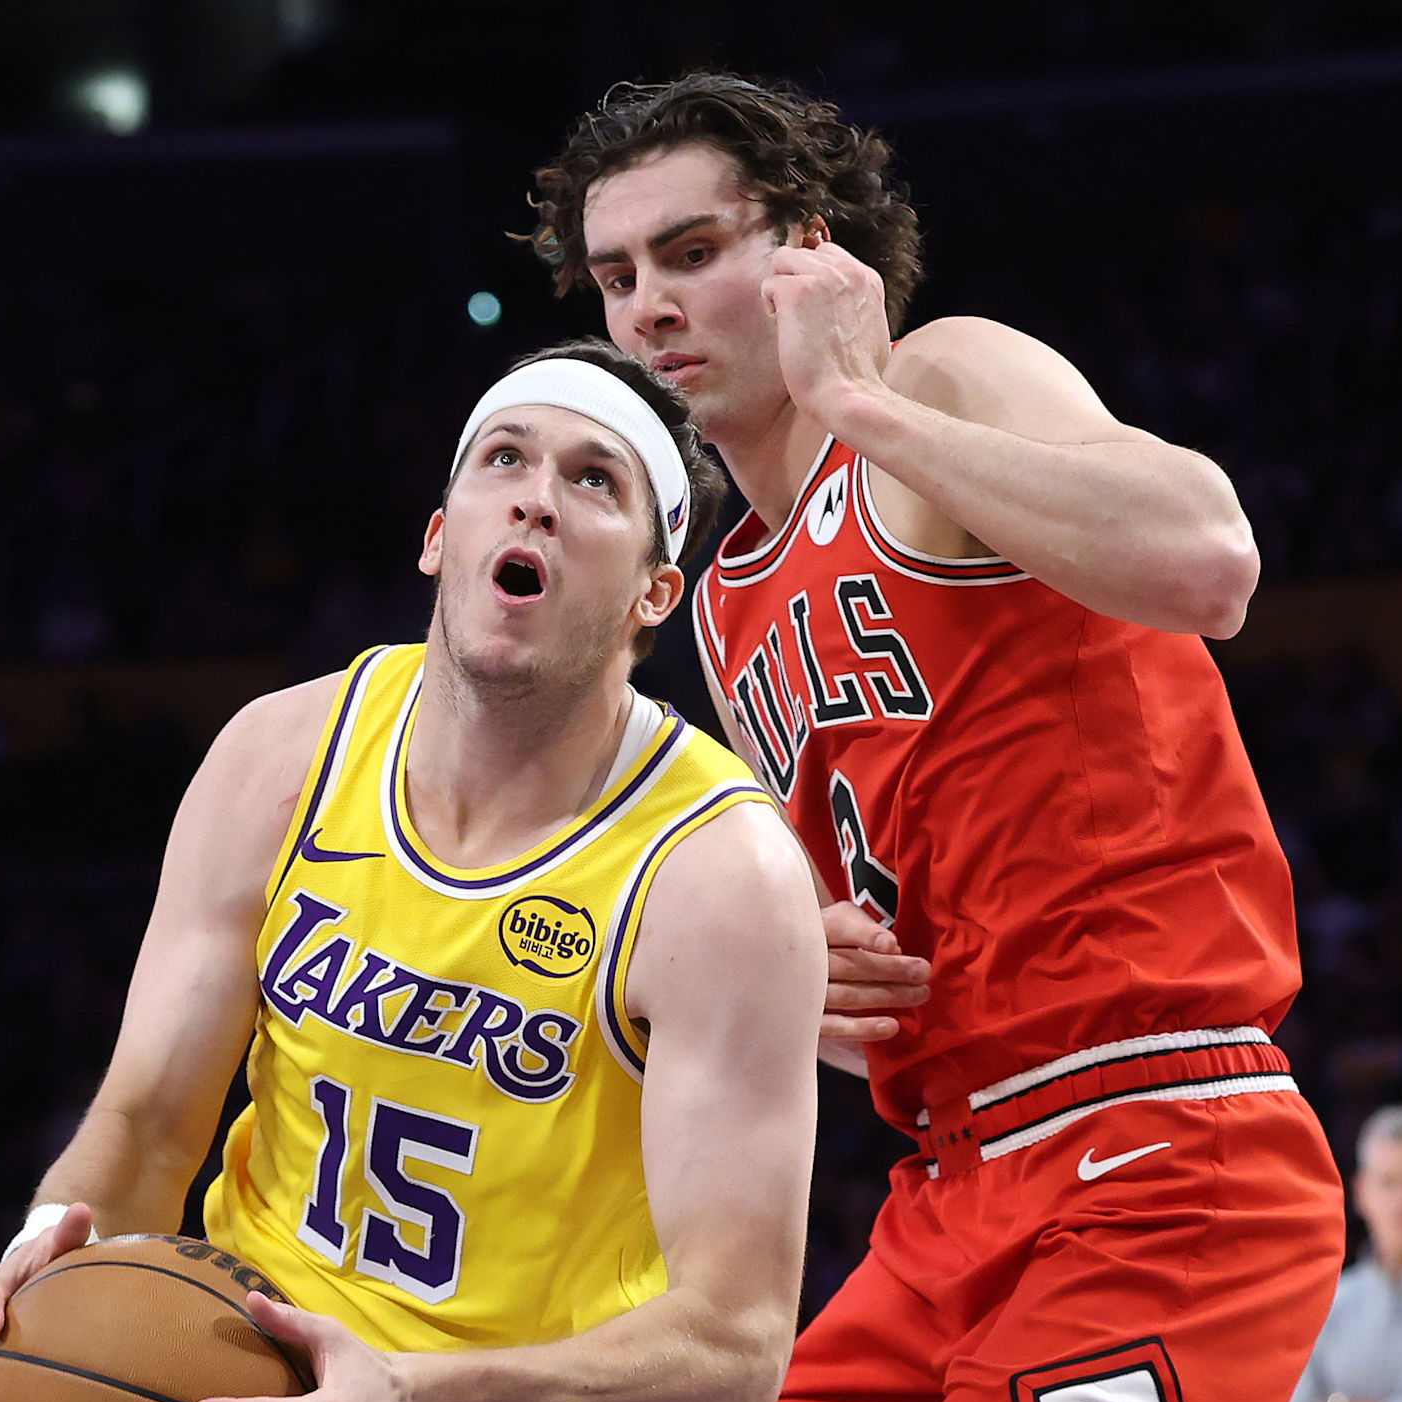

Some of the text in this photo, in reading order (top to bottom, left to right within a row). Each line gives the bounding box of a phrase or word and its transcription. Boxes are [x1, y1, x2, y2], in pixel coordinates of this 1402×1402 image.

[729, 573, 935, 803] ULLS
[261, 888, 583, 1104] LAKERS
[509, 909, 591, 959] bibigo
[519, 938, 554, 960] 비비고
[296, 1073, 480, 1305] 15
